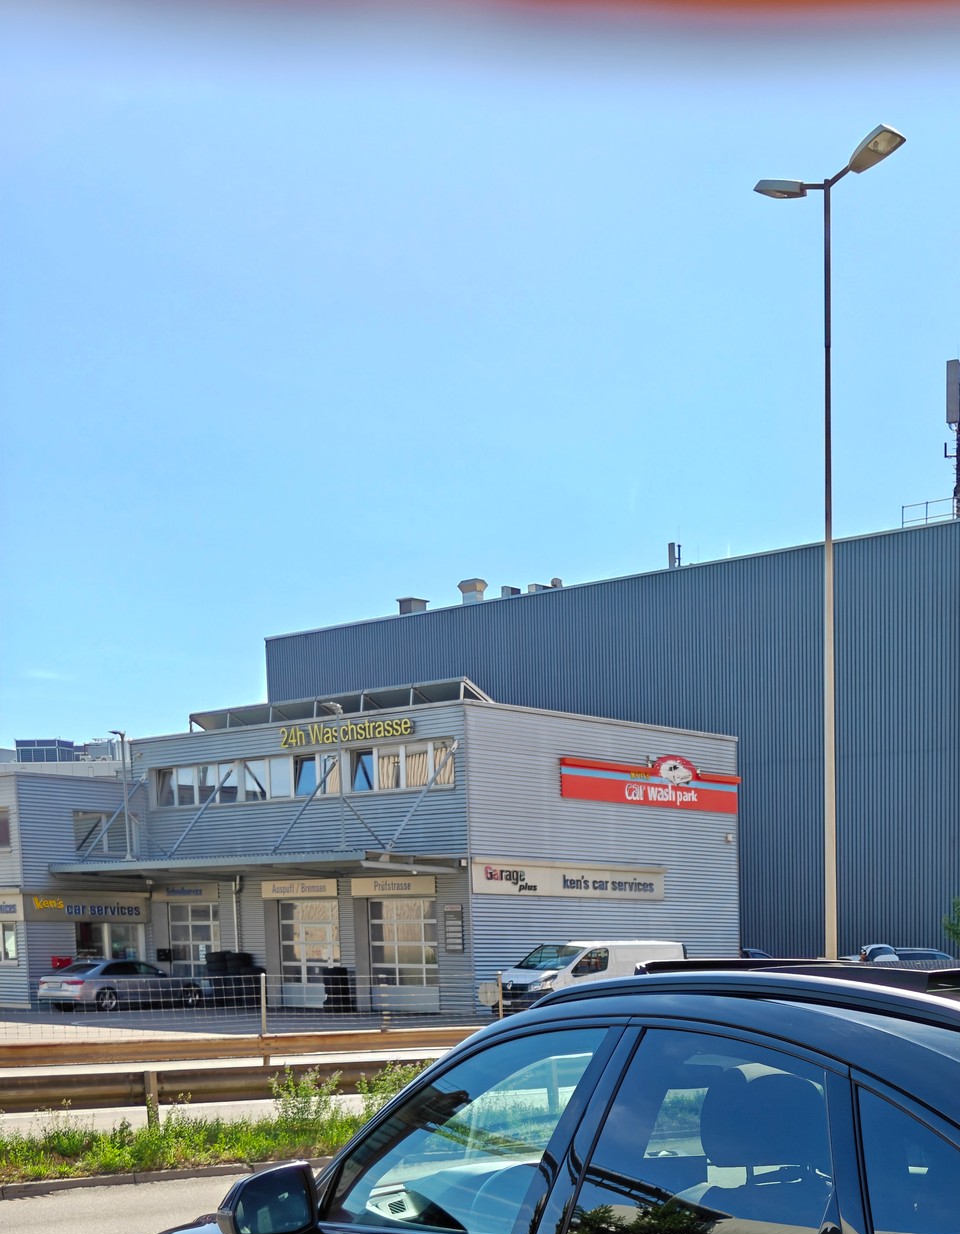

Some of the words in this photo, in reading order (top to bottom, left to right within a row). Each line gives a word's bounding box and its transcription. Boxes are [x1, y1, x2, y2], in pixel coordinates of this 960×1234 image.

[280, 725, 306, 748] 24h
[308, 718, 411, 745] Waschstrasse
[677, 790, 698, 806] park
[484, 865, 526, 885] Garage
[373, 880, 412, 893] Prüfstrasse
[518, 883, 538, 893] plus
[562, 874, 589, 890] ken's
[592, 879, 609, 891] car
[611, 878, 655, 893] services
[66, 904, 86, 915] car
[89, 902, 140, 916] services
